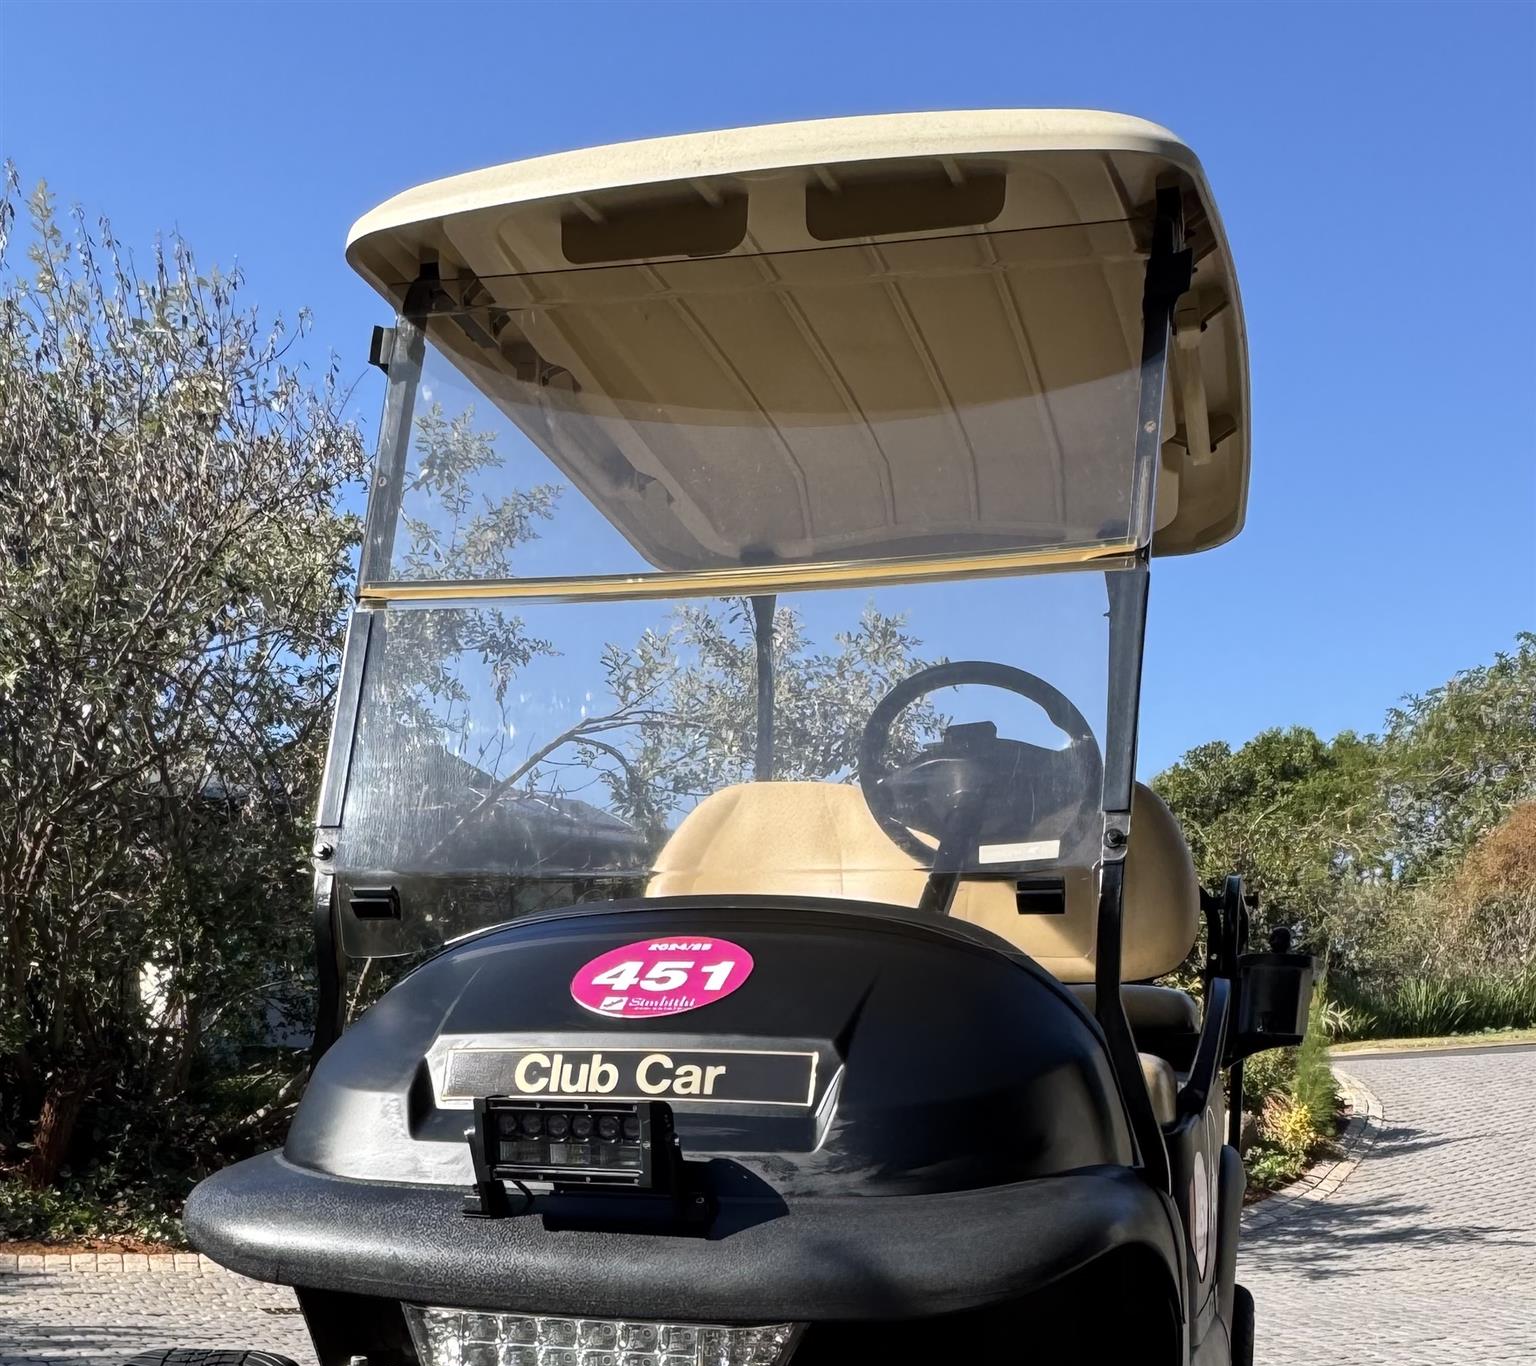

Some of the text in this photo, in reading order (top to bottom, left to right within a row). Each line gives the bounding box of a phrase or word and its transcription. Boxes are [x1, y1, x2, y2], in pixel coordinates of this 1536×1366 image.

[592, 961, 735, 991] 451
[514, 1053, 726, 1095] Club Car
